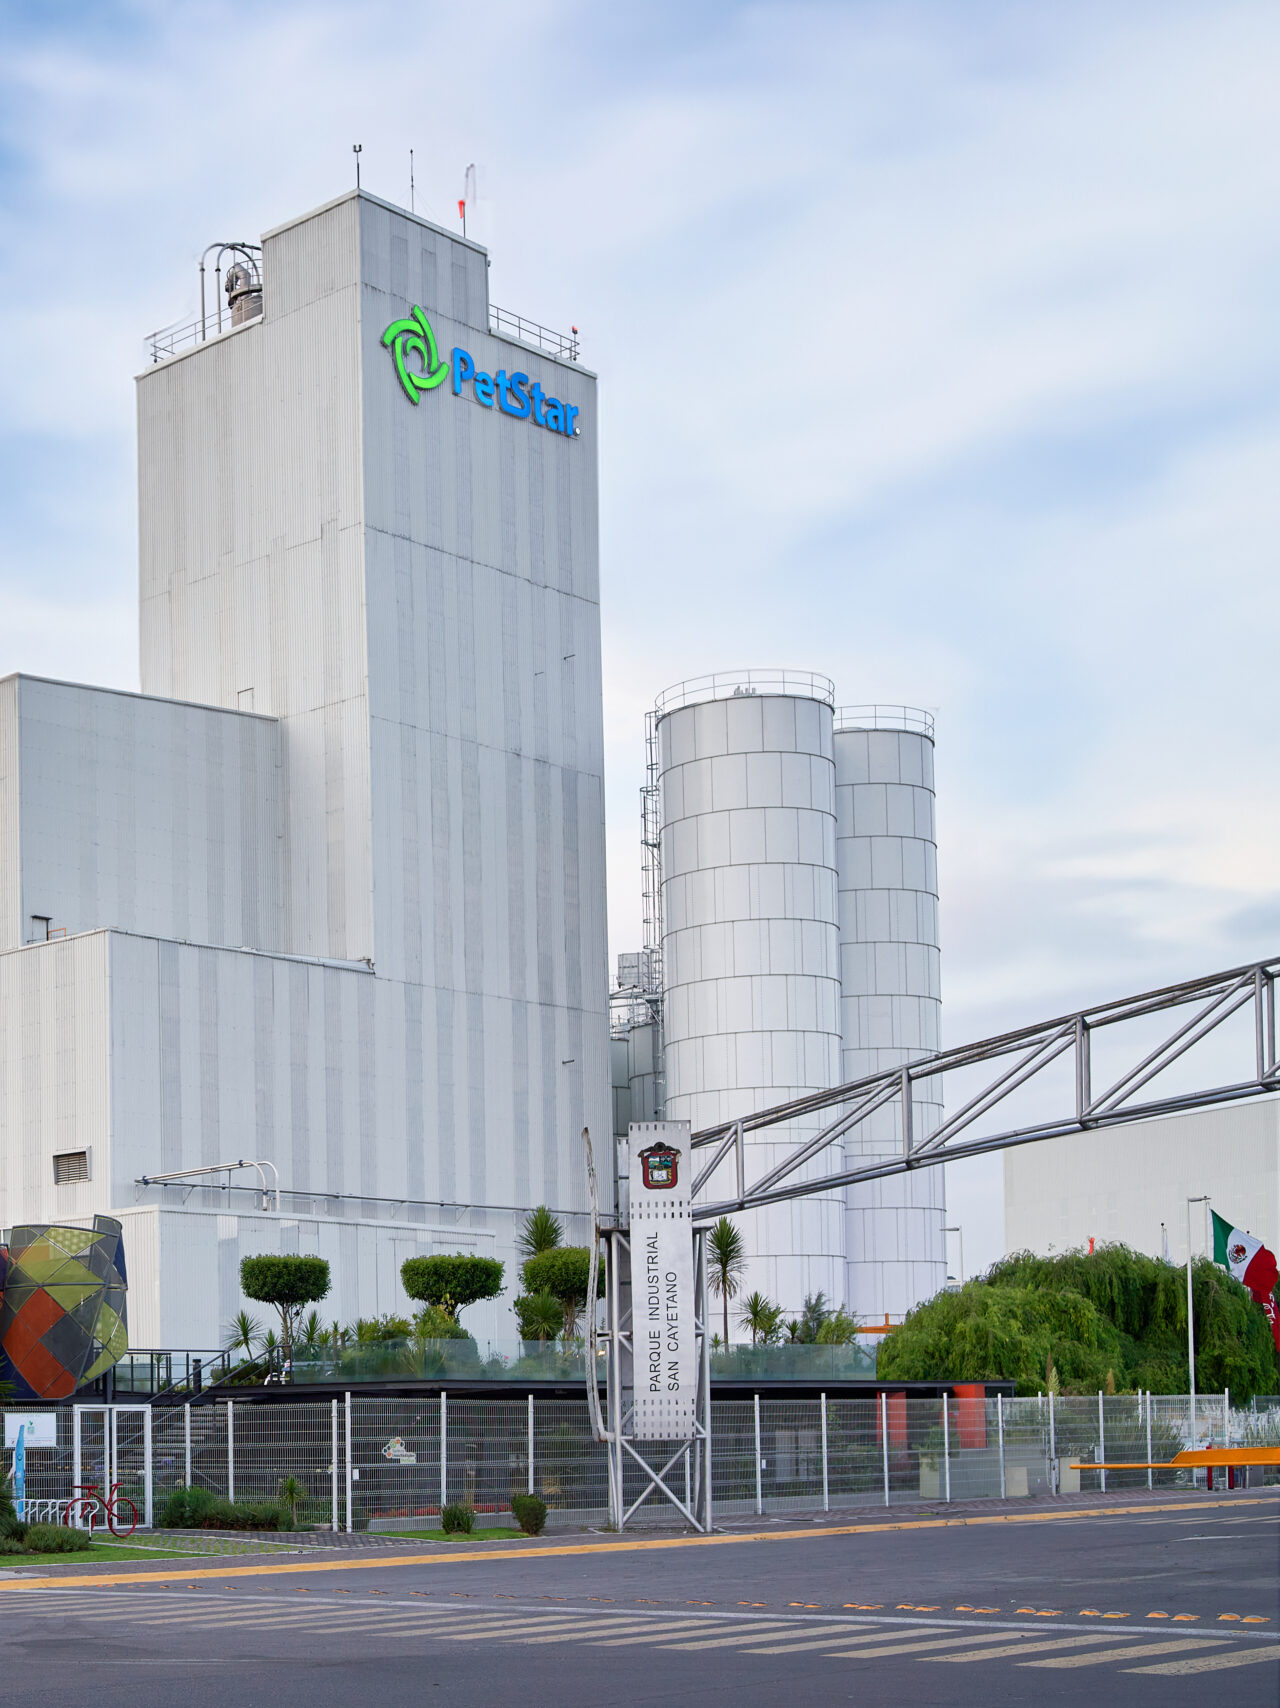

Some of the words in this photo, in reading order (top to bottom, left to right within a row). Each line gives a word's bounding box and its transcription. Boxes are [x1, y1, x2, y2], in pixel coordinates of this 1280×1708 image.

[452, 346, 579, 437] PetStar
[646, 1231, 660, 1320] INDUSTRIAL
[665, 1271, 679, 1352] CAYETANO
[648, 1330, 661, 1392] PARQUE
[667, 1361, 680, 1392] SAN
